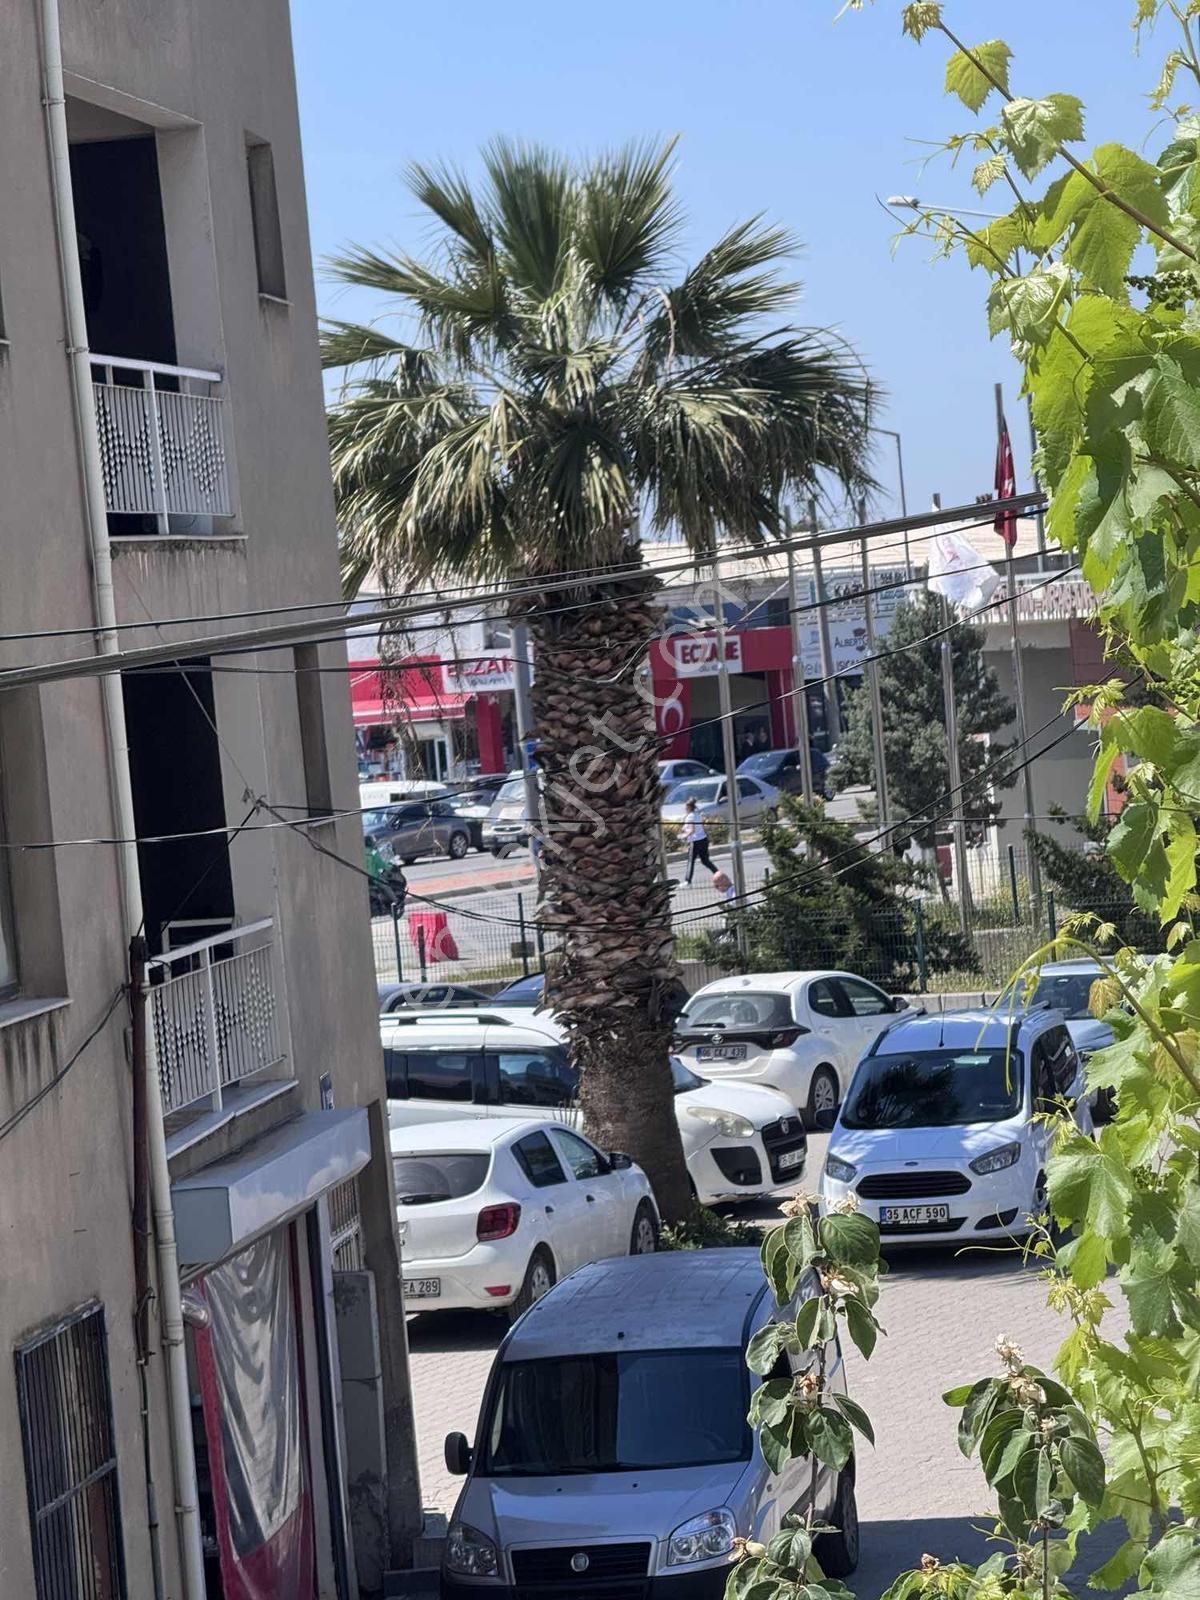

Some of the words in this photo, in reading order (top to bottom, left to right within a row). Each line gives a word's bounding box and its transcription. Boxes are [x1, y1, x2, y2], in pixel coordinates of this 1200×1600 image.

[886, 1209, 899, 1220] 35
[903, 1207, 922, 1220] ACF
[925, 1207, 946, 1219] 590
[418, 1280, 438, 1293] 289
